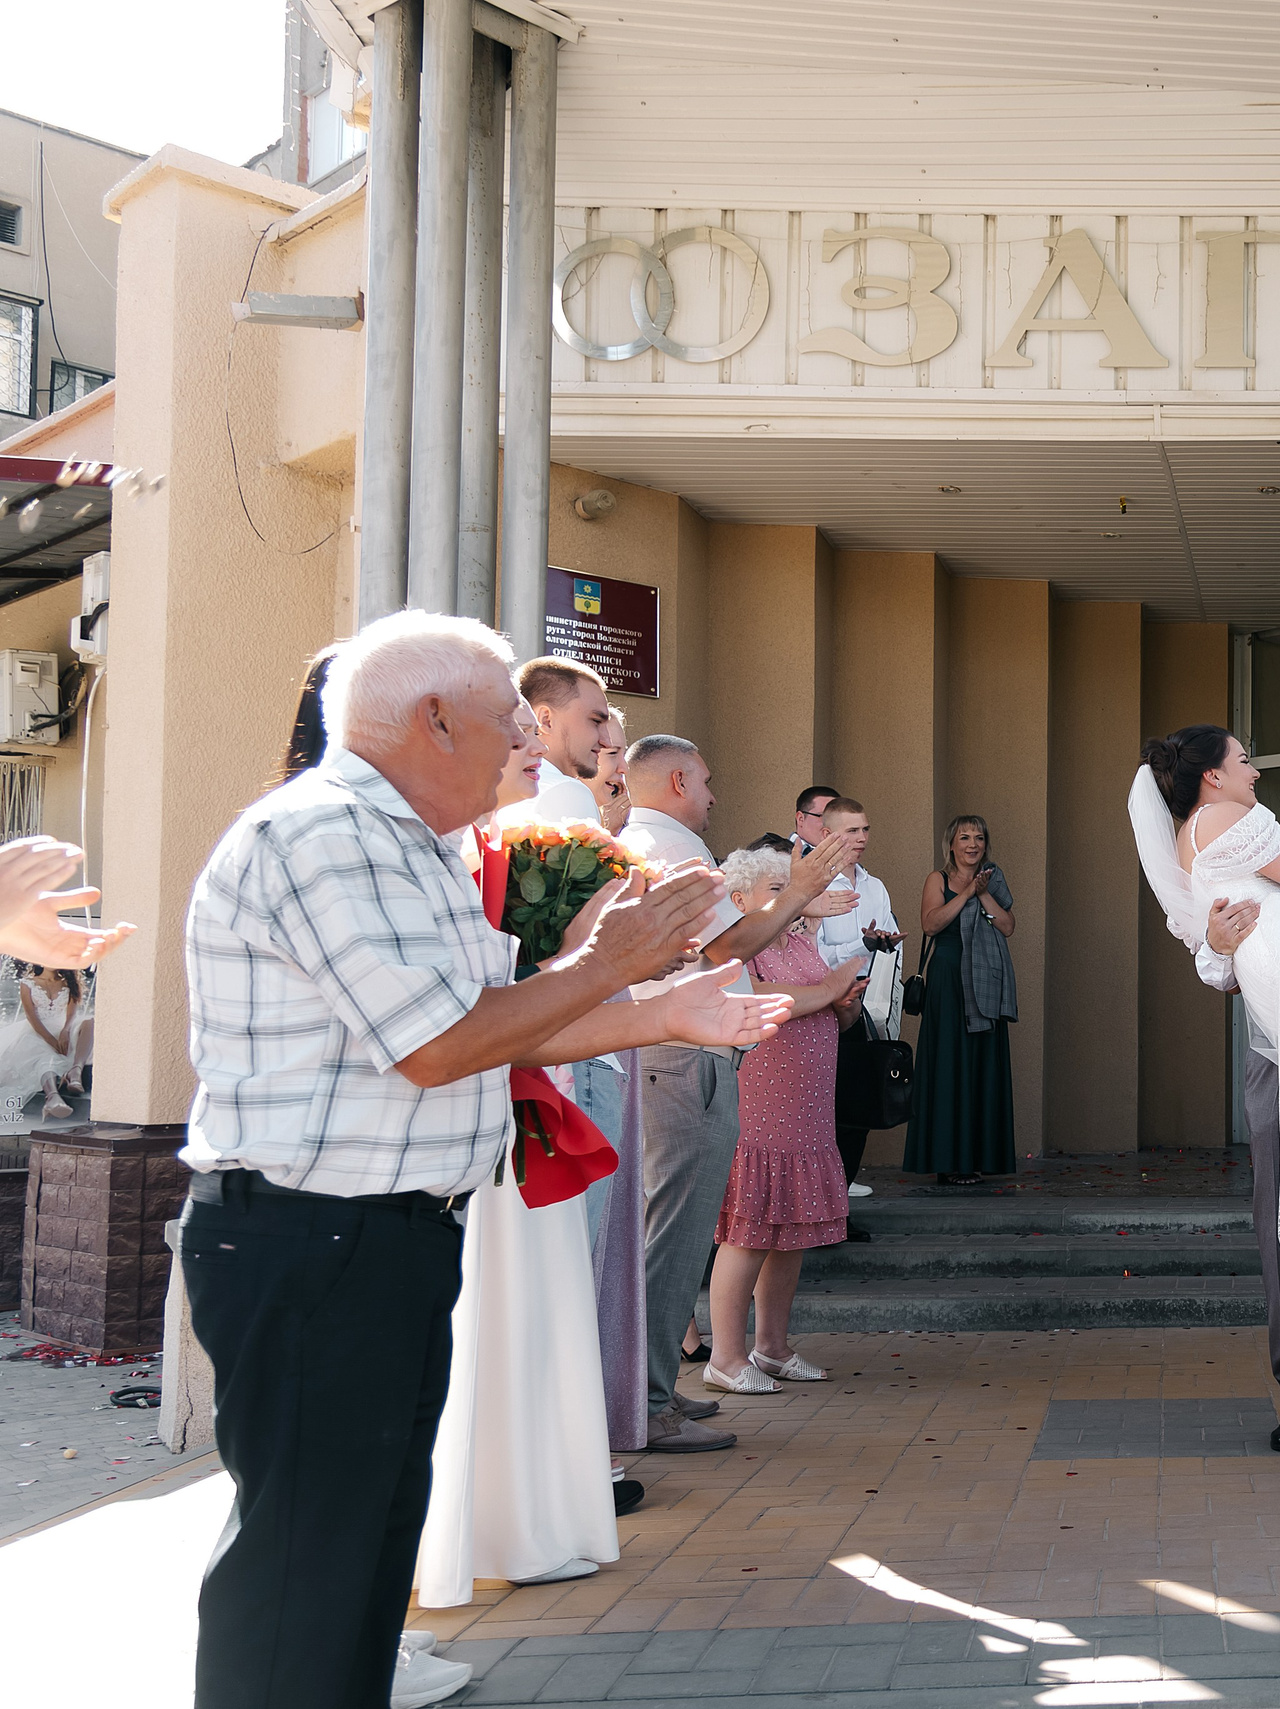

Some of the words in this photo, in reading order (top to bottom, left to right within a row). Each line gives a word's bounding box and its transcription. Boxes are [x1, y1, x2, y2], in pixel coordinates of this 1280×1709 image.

[546, 615, 598, 630] инистрация
[600, 625, 642, 638] городского
[546, 625, 566, 635] руга
[572, 630, 595, 640] город
[597, 632, 637, 646] Волжский
[546, 635, 601, 650] олгоградской
[603, 644, 634, 656] области
[553, 647, 584, 660] ОТДЕЛ
[585, 653, 622, 666] ЗАПИСИ
[583, 662, 641, 679] ДАНСКОГО
[610, 677, 624, 686] №2
